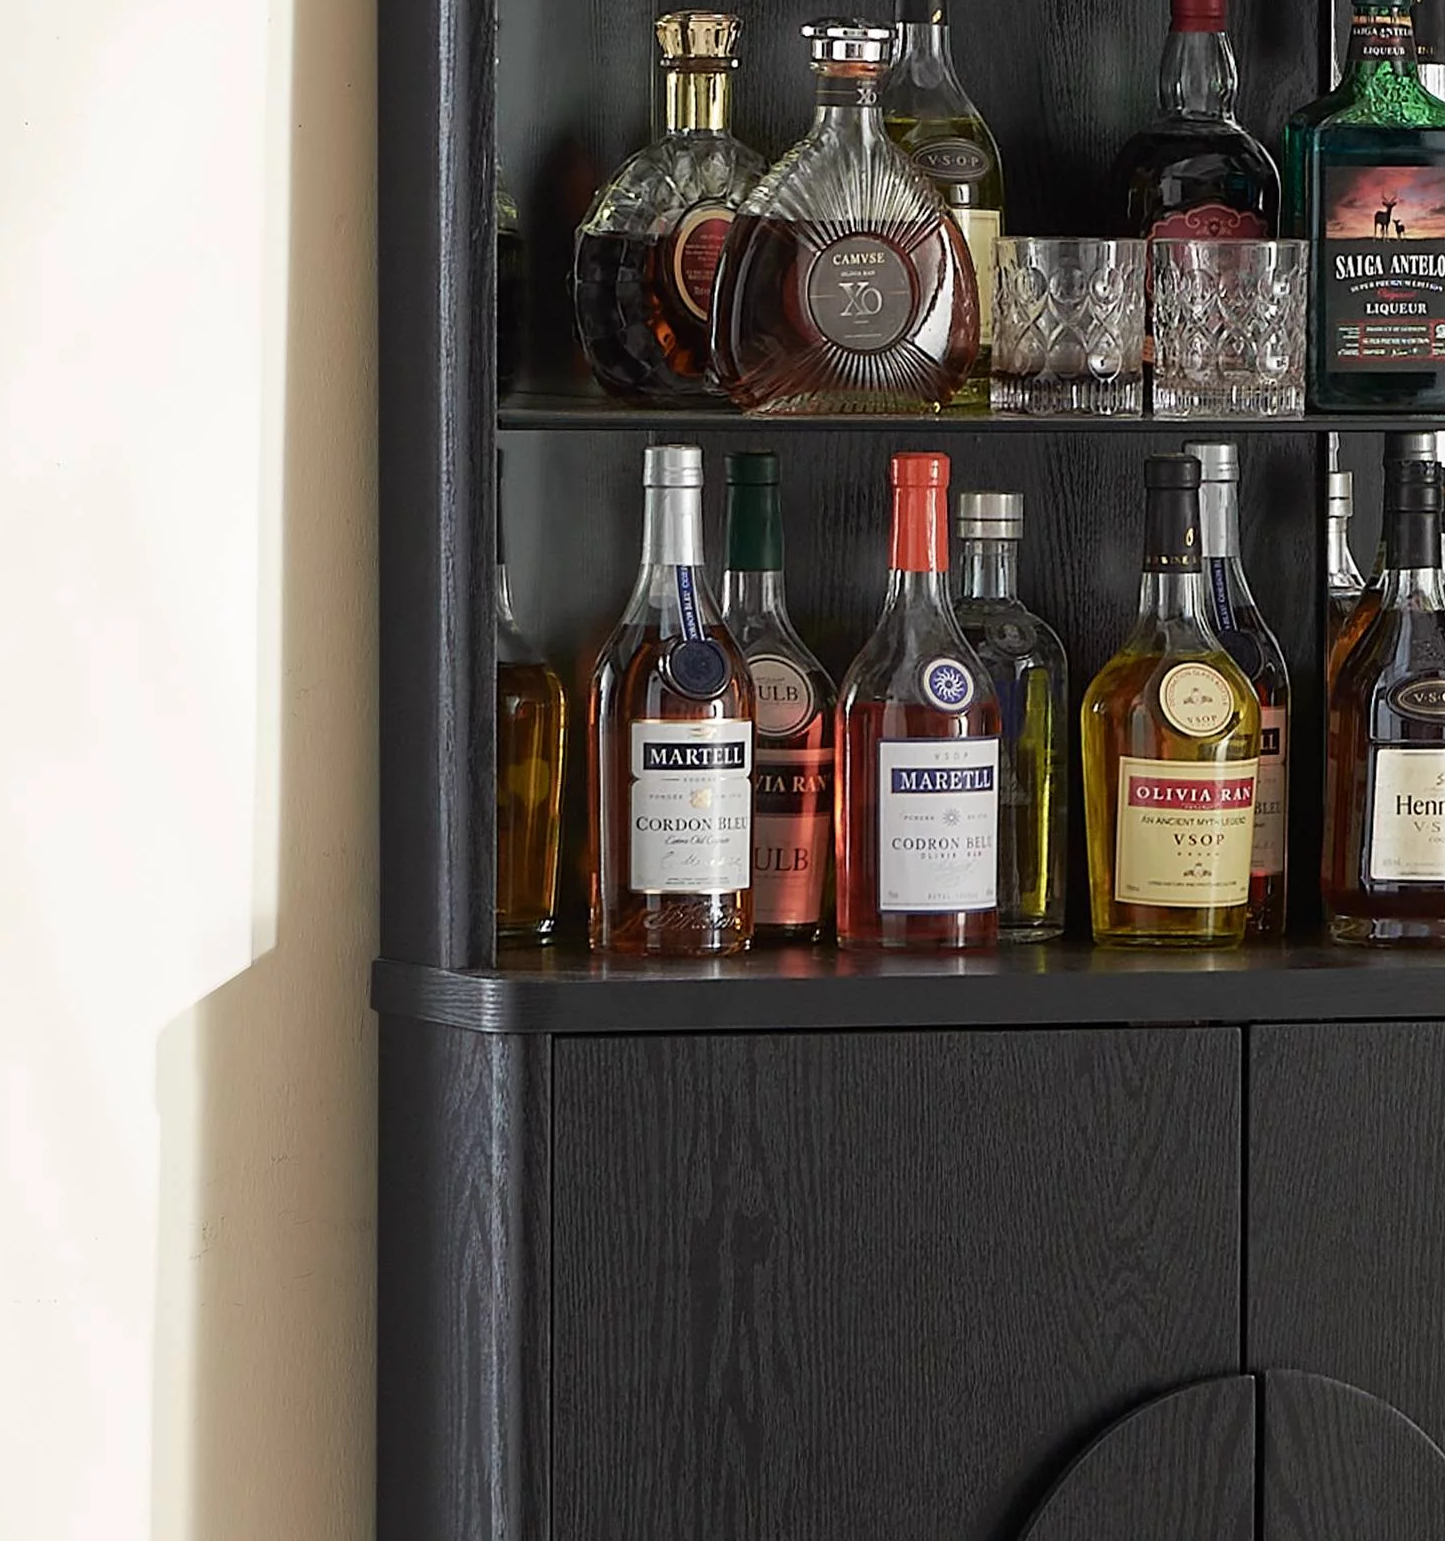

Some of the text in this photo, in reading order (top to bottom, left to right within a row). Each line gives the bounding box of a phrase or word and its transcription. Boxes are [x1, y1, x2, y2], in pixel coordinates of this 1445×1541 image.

[832, 251, 885, 266] CAMVSE
[1335, 254, 1384, 279] SAIGA
[838, 281, 883, 317] XO
[1365, 302, 1428, 316] LIQUEUR
[758, 685, 799, 701] ULB
[650, 747, 742, 765] MARTELL
[900, 769, 991, 791] MARETLL
[1136, 785, 1251, 802] OLIVIA RAN
[636, 815, 711, 832] CORDON
[891, 836, 960, 851] CODRON
[1174, 833, 1225, 846] VSOP
[754, 846, 809, 873] ULB
